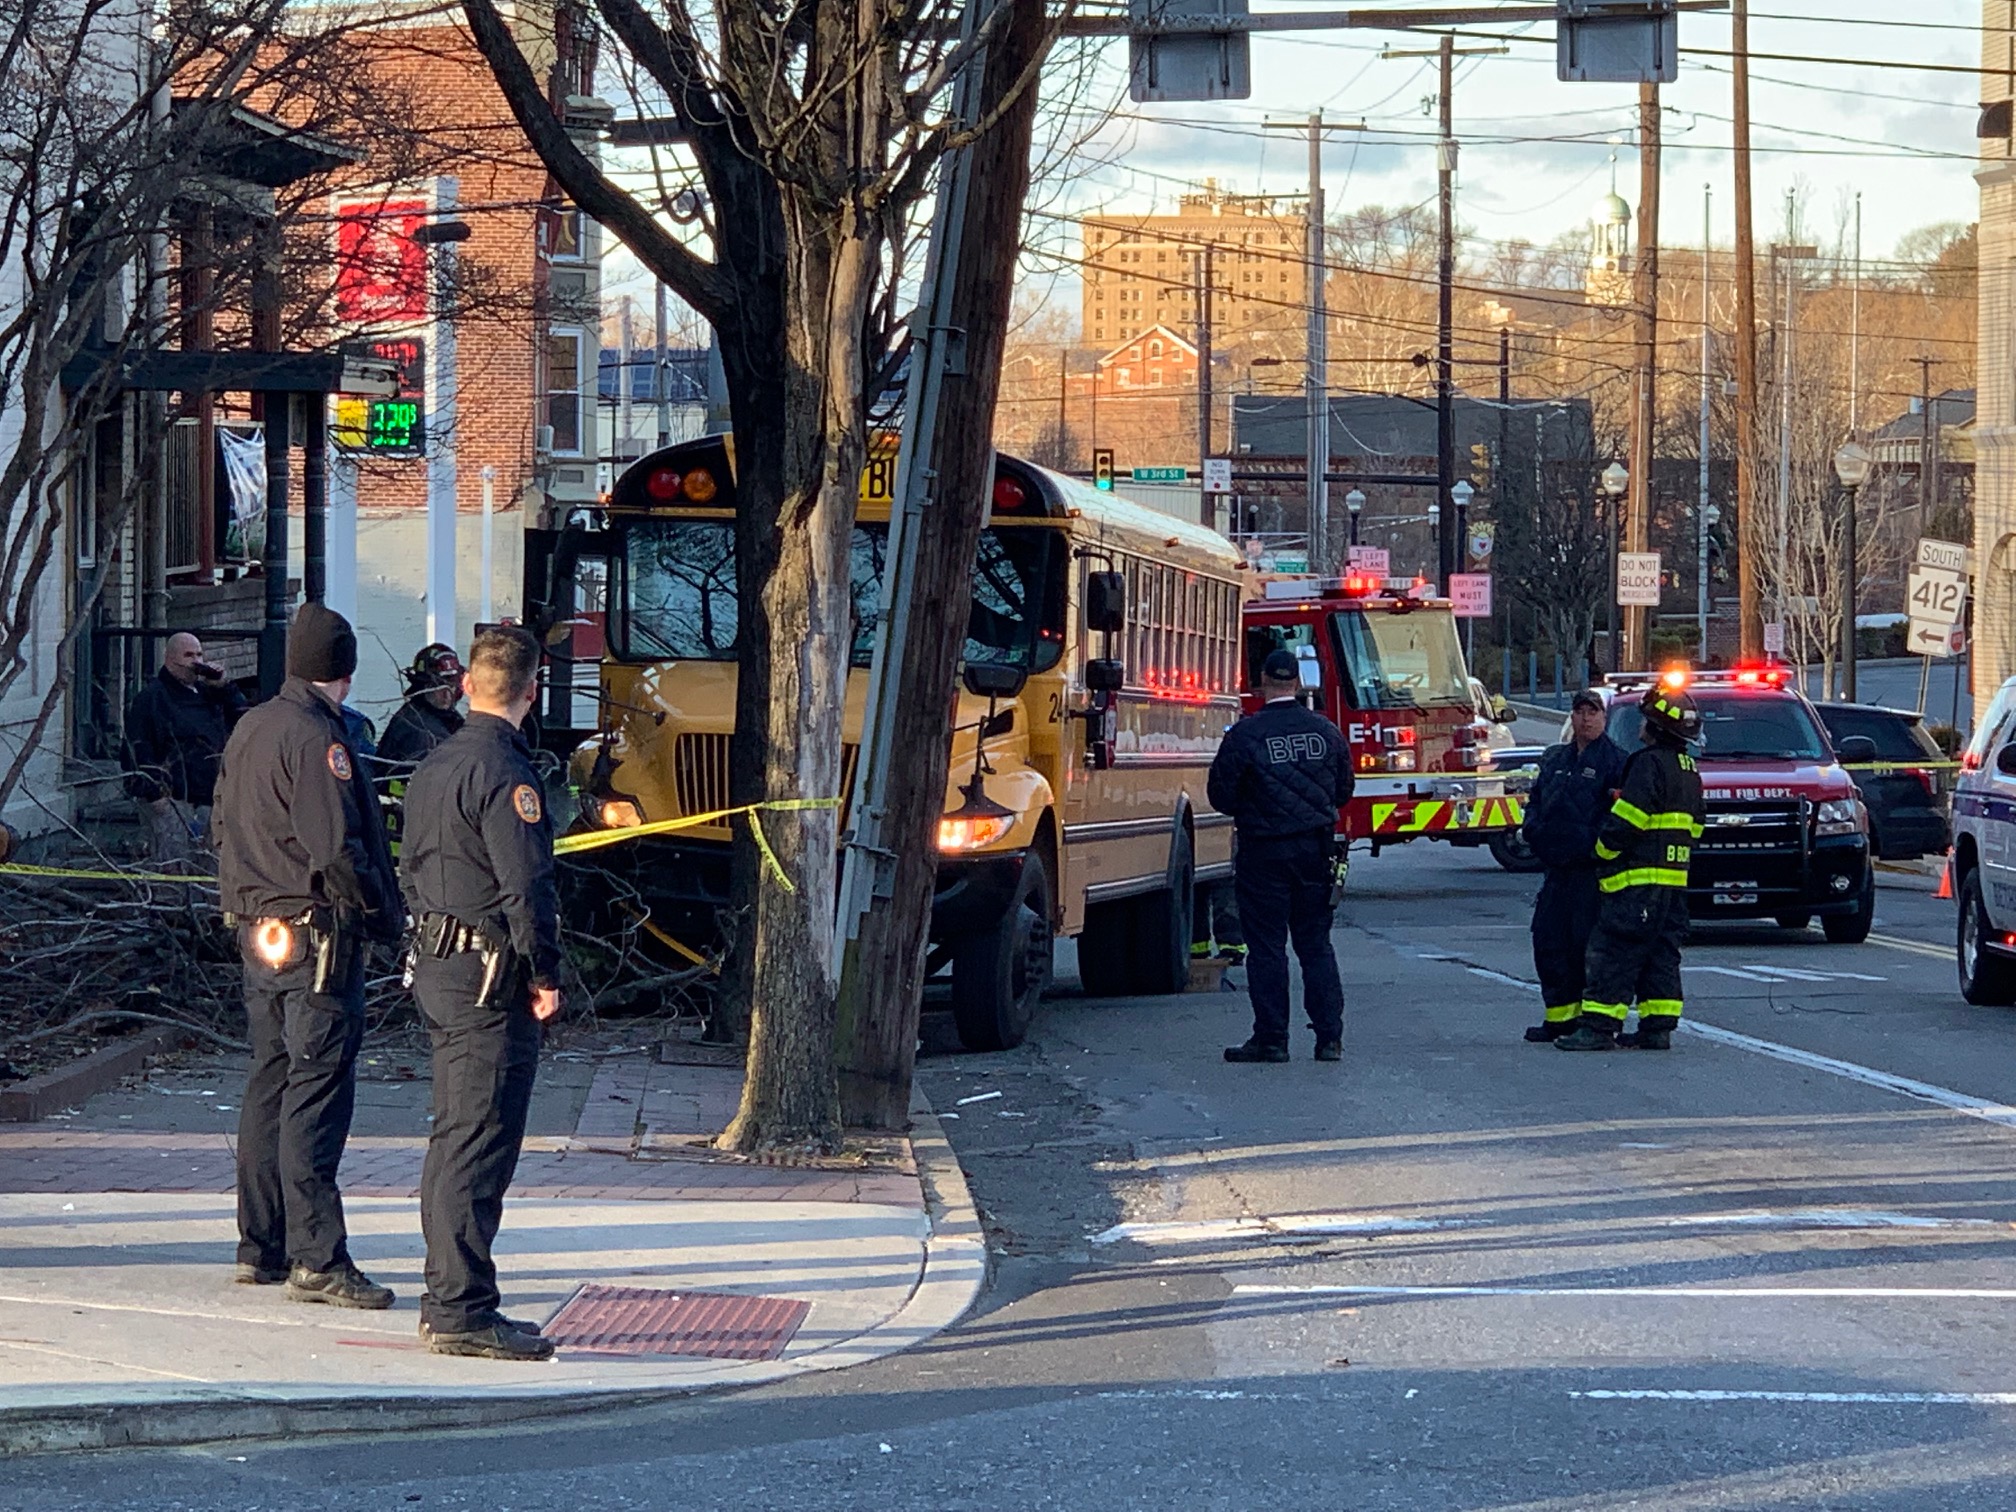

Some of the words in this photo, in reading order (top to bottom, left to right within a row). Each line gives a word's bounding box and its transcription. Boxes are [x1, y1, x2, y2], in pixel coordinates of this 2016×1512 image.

[869, 459, 895, 498] BU
[1140, 470, 1149, 478] W
[1151, 469, 1167, 478] 3rd
[1169, 470, 1179, 478] St
[1365, 552, 1385, 560] LEFT
[1922, 544, 1962, 568] SOUTH
[1364, 561, 1386, 569] LANE
[1621, 560, 1635, 571] DO
[1639, 560, 1657, 571] NOT
[1471, 580, 1488, 588] LANE
[1621, 575, 1657, 588] BLOCK
[1459, 591, 1482, 600] MUST
[1912, 580, 1958, 613] 412
[1349, 722, 1382, 744] E-1
[1266, 733, 1327, 764] BFD
[1736, 788, 1761, 799] FIRE
[1764, 788, 1794, 799] DEPT.
[1666, 844, 1676, 862] B
